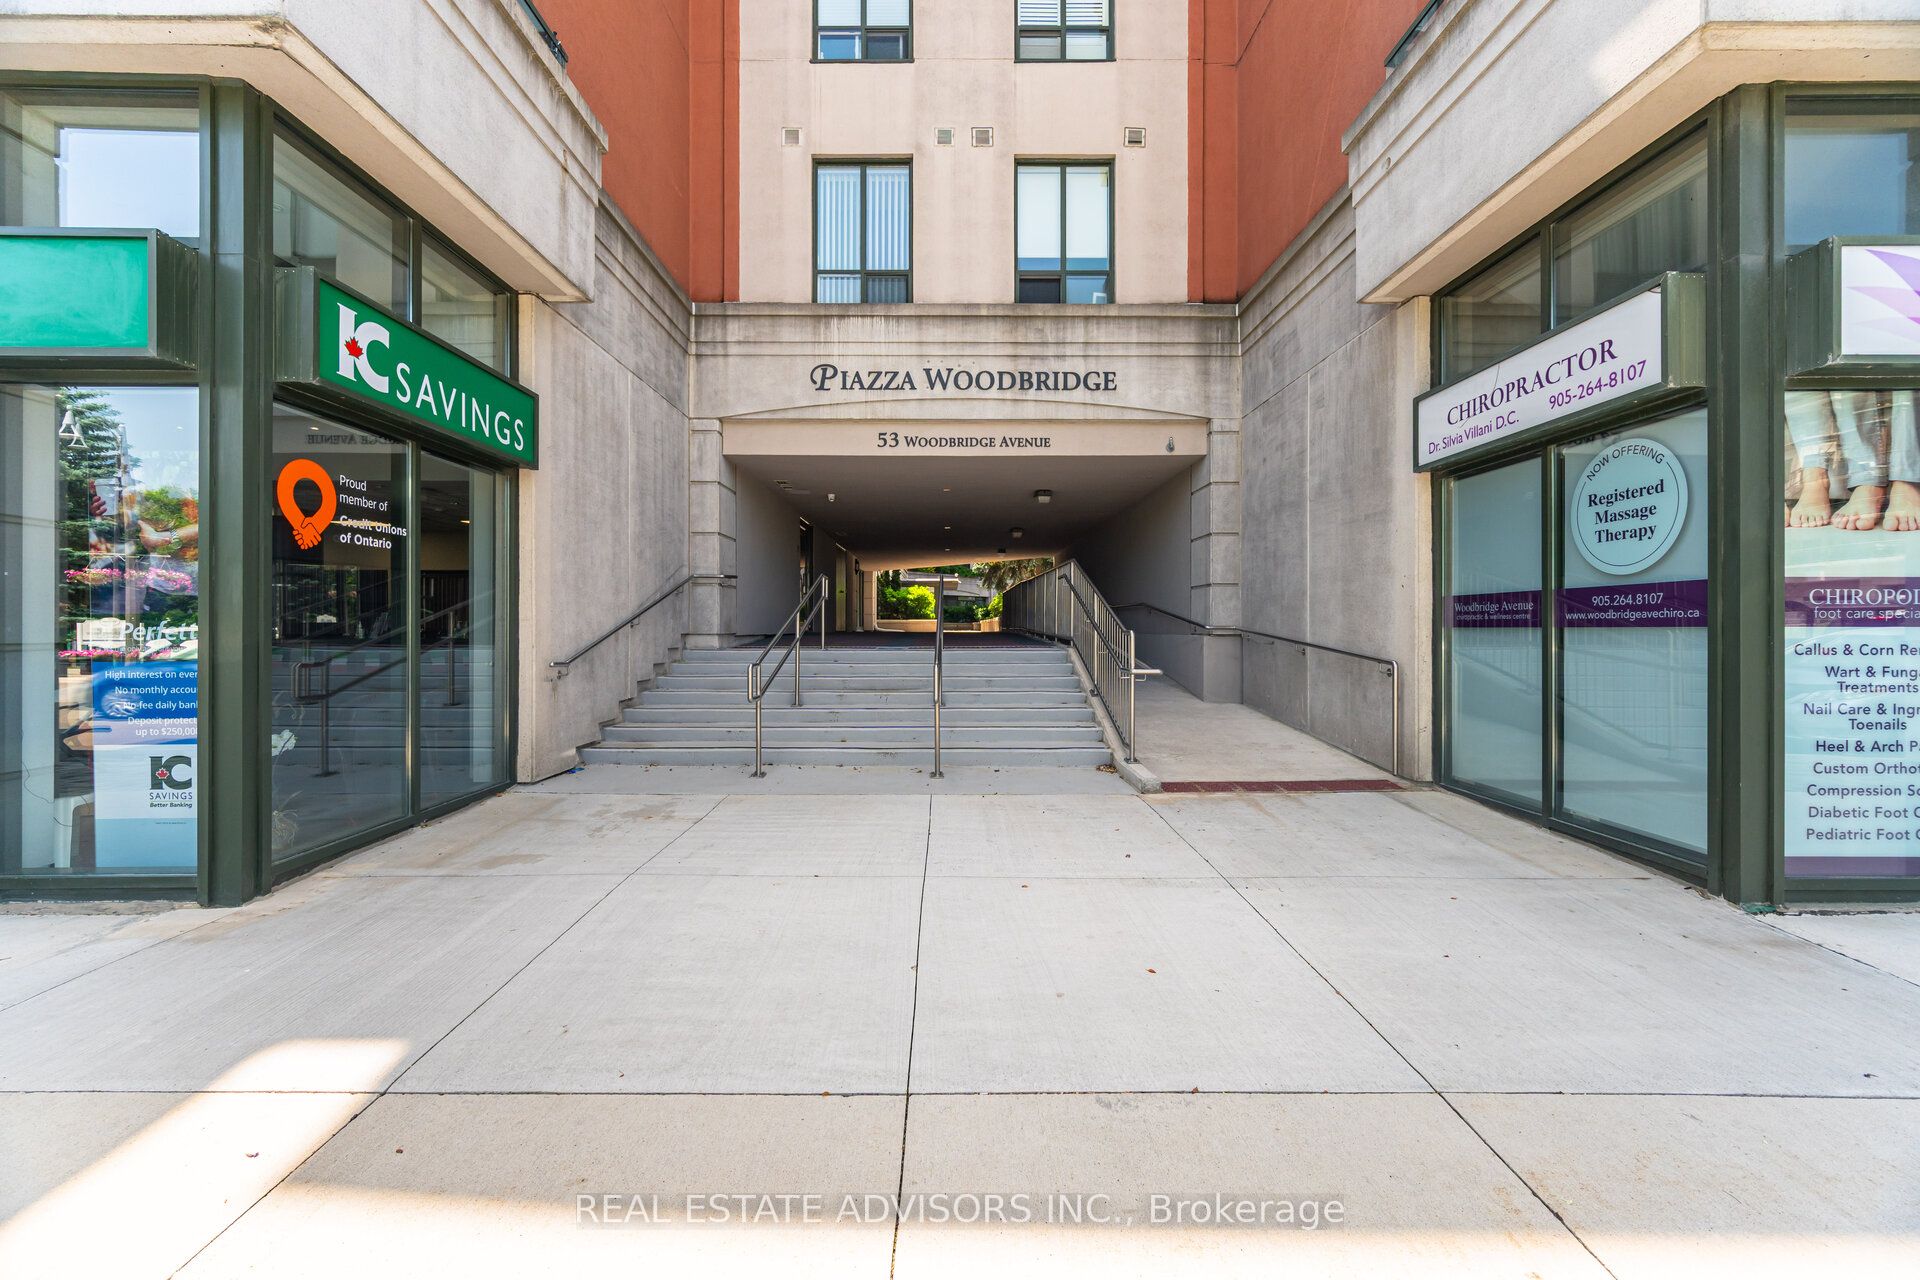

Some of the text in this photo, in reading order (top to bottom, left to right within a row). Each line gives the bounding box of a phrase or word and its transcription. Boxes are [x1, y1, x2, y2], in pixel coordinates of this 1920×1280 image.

[810, 363, 1118, 392] PIAZZA WOODBRIDGE
[1447, 339, 1618, 426] CHIROPRACTOR
[1549, 360, 1647, 410] 905-264-8107
[396, 362, 525, 452] SAVINGS
[1428, 410, 1520, 455] Dr. Silvia Villani D.C.
[876, 432, 1052, 449] 53 WOODBRIDGE AVENUE
[1586, 444, 1665, 482] NOW OFFERING
[339, 474, 367, 492] Proud
[1587, 478, 1665, 508] Registered
[339, 493, 388, 512] member of
[1594, 504, 1657, 525] Massage
[340, 533, 392, 549] of Ontario
[1594, 525, 1657, 544] Therapy
[1592, 592, 1664, 607] 905.264.8107
[1454, 601, 1534, 614] Woodbridge Avenue
[1814, 606, 1842, 619] foot
[1846, 609, 1874, 619] care
[1565, 608, 1700, 622] www.woodbridgeavechiro.ca
[1794, 643, 1837, 656] Callus
[1843, 643, 1854, 656] &
[1859, 643, 1894, 656] Corn
[104, 670, 126, 681] High
[128, 670, 163, 679] interest
[166, 671, 177, 679] on
[1825, 666, 1920, 681] Wart & Fung
[115, 686, 129, 695] No
[130, 686, 168, 696] monthly
[1837, 681, 1919, 694] Treatments
[156, 700, 177, 711] daily
[179, 700, 198, 709] ban
[1804, 702, 1832, 715] Nail
[1837, 702, 1871, 715] Care
[1876, 702, 1887, 715] &
[127, 716, 163, 726] Deposit
[1848, 717, 1907, 730] Toenails
[135, 729, 147, 738] up
[150, 728, 159, 736] to
[1815, 739, 1920, 753] Heel & Arch P
[1813, 762, 1869, 775] Custom
[149, 791, 193, 800] SAVINGS
[1807, 784, 1902, 800] Compression
[1808, 805, 1870, 819] Diabetic
[1875, 806, 1909, 819] Foot
[1806, 828, 1872, 841] Pediatric
[1876, 828, 1911, 841] Foot
